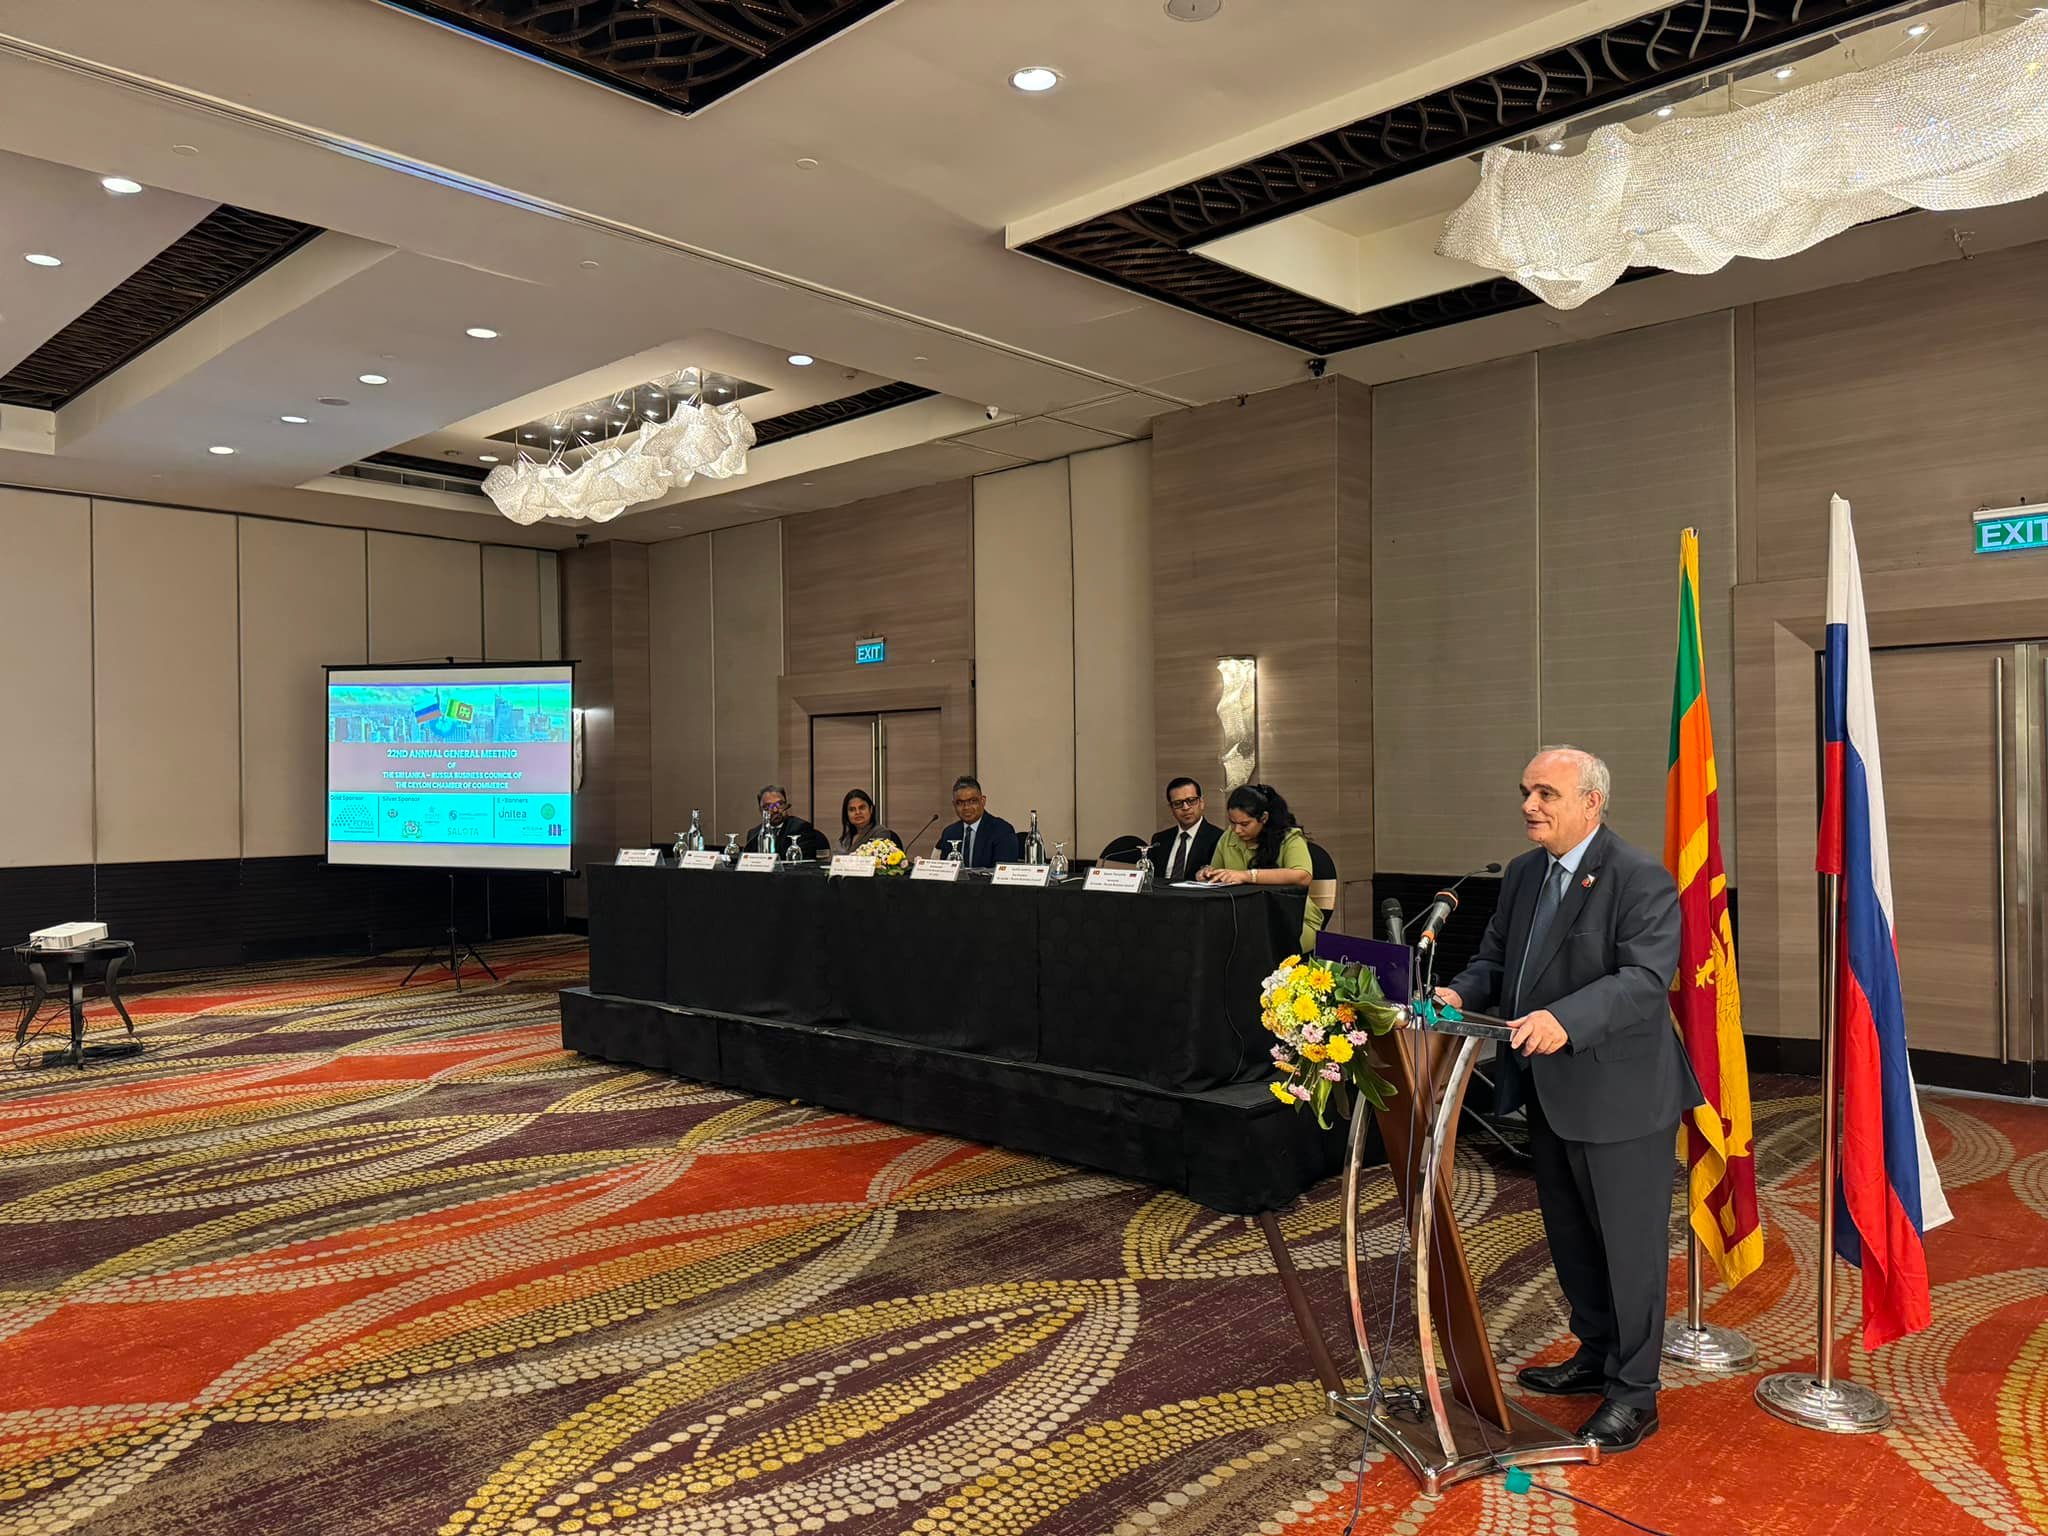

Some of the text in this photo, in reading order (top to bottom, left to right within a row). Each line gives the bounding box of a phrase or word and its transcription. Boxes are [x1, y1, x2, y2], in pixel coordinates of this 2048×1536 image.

[1982, 519, 2048, 547] EXIT
[858, 646, 881, 661] EXIT
[387, 749, 518, 758] 22ND ANNUAL GENERAL MEETING
